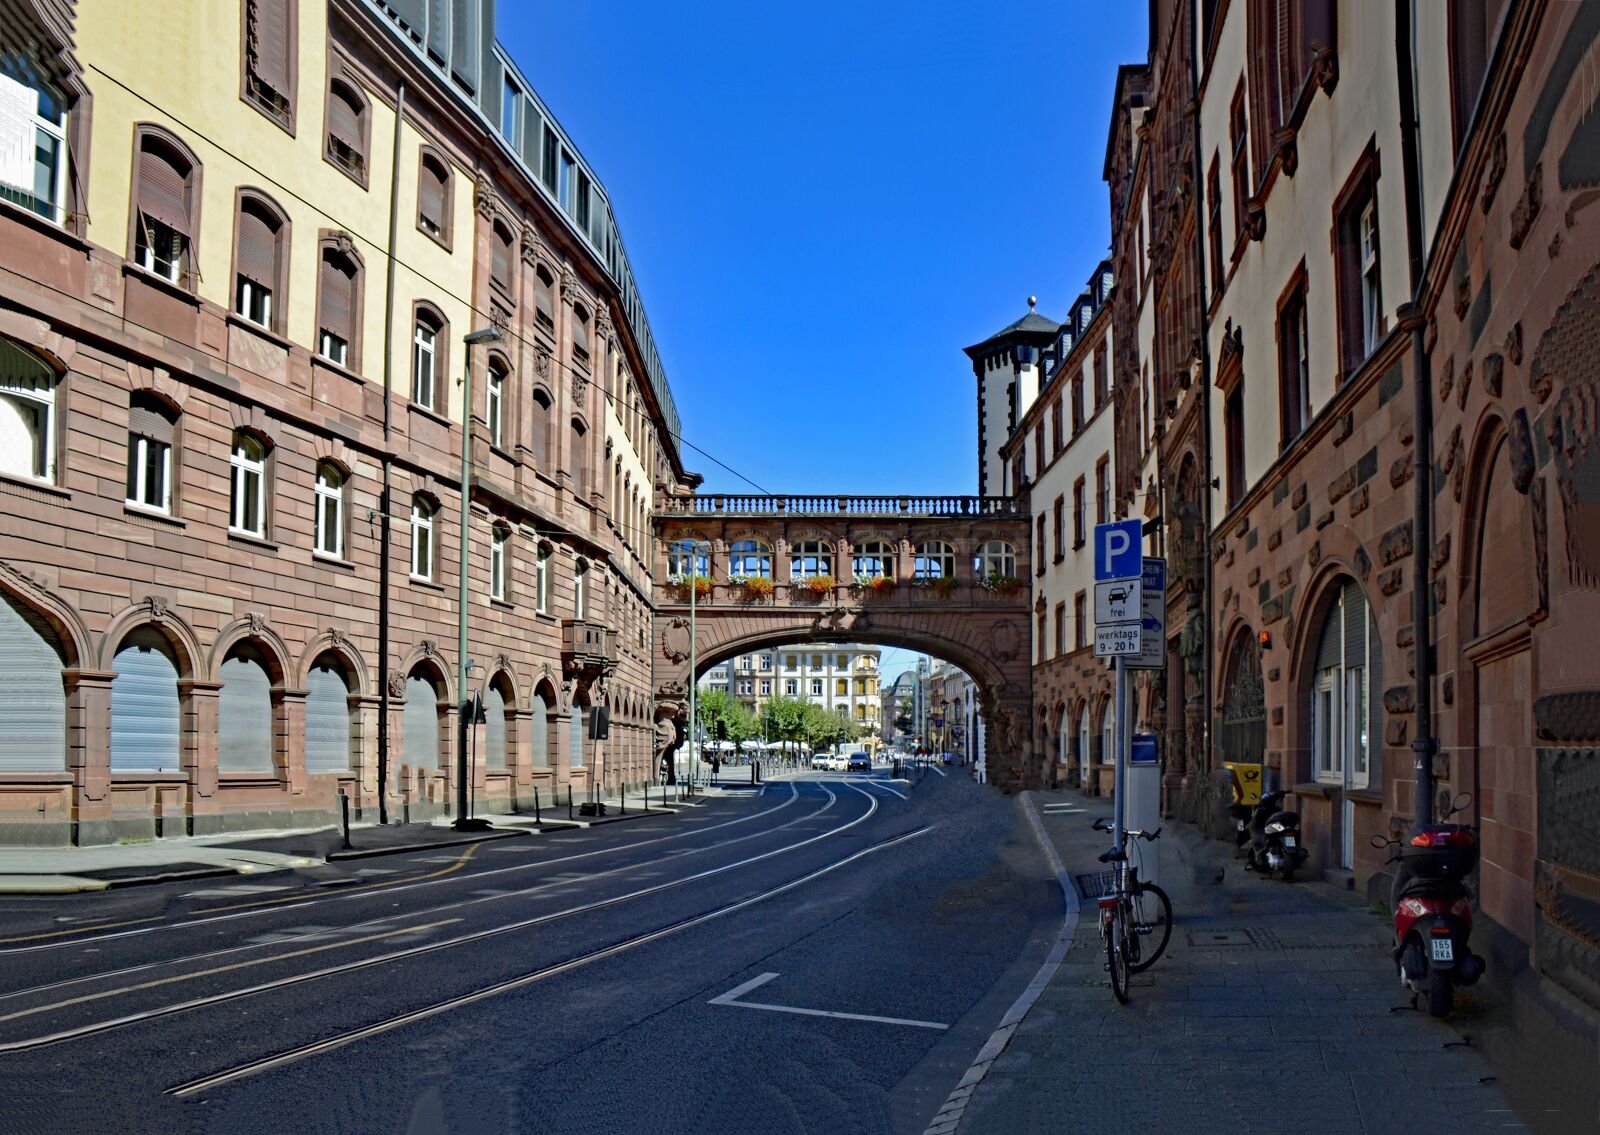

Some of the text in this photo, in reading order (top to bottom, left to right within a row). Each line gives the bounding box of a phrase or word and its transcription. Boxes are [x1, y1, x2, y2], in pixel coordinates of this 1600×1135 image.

[1105, 529, 1131, 573] P
[1110, 607, 1126, 617] frei
[1098, 629, 1138, 640] werktags
[1100, 642, 1106, 652] 9
[1114, 641, 1126, 651] 20
[1128, 640, 1135, 650] h
[1434, 940, 1450, 949] 165
[1435, 950, 1451, 958] RKA
